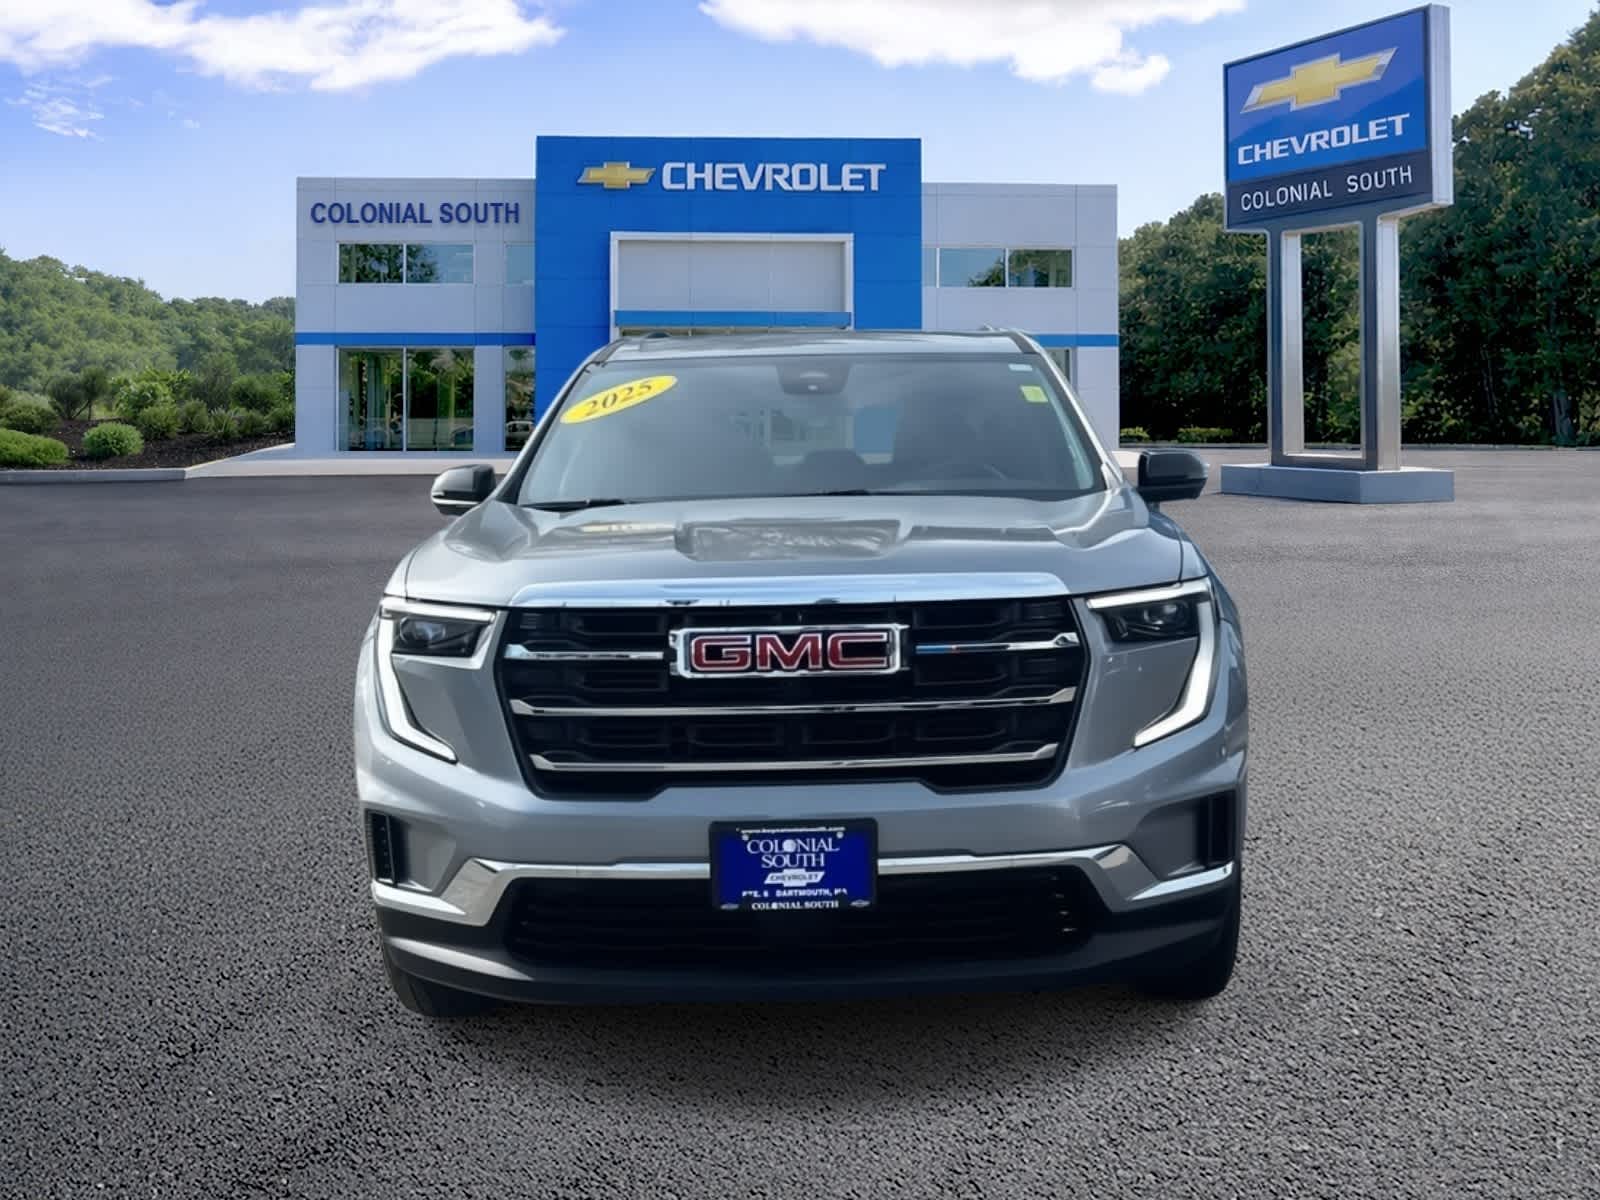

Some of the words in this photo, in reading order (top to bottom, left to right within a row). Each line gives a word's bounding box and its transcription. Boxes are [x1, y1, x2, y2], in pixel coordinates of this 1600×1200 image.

[1237, 112, 1410, 165] CHEVROLET
[662, 161, 886, 191] CHEVROLET
[1240, 179, 1333, 212] COLONIAL
[1346, 165, 1413, 194] SOUTH
[310, 202, 433, 224] COLONIAL
[439, 202, 520, 224] SOUTH
[584, 383, 653, 417] 2025
[691, 631, 888, 672] GMC
[746, 837, 840, 854] COLONIAL
[761, 853, 825, 868] SOUTH
[769, 872, 820, 882] CHEVROLET
[751, 900, 803, 911] COLONIAL
[804, 899, 839, 909] SOUTH
